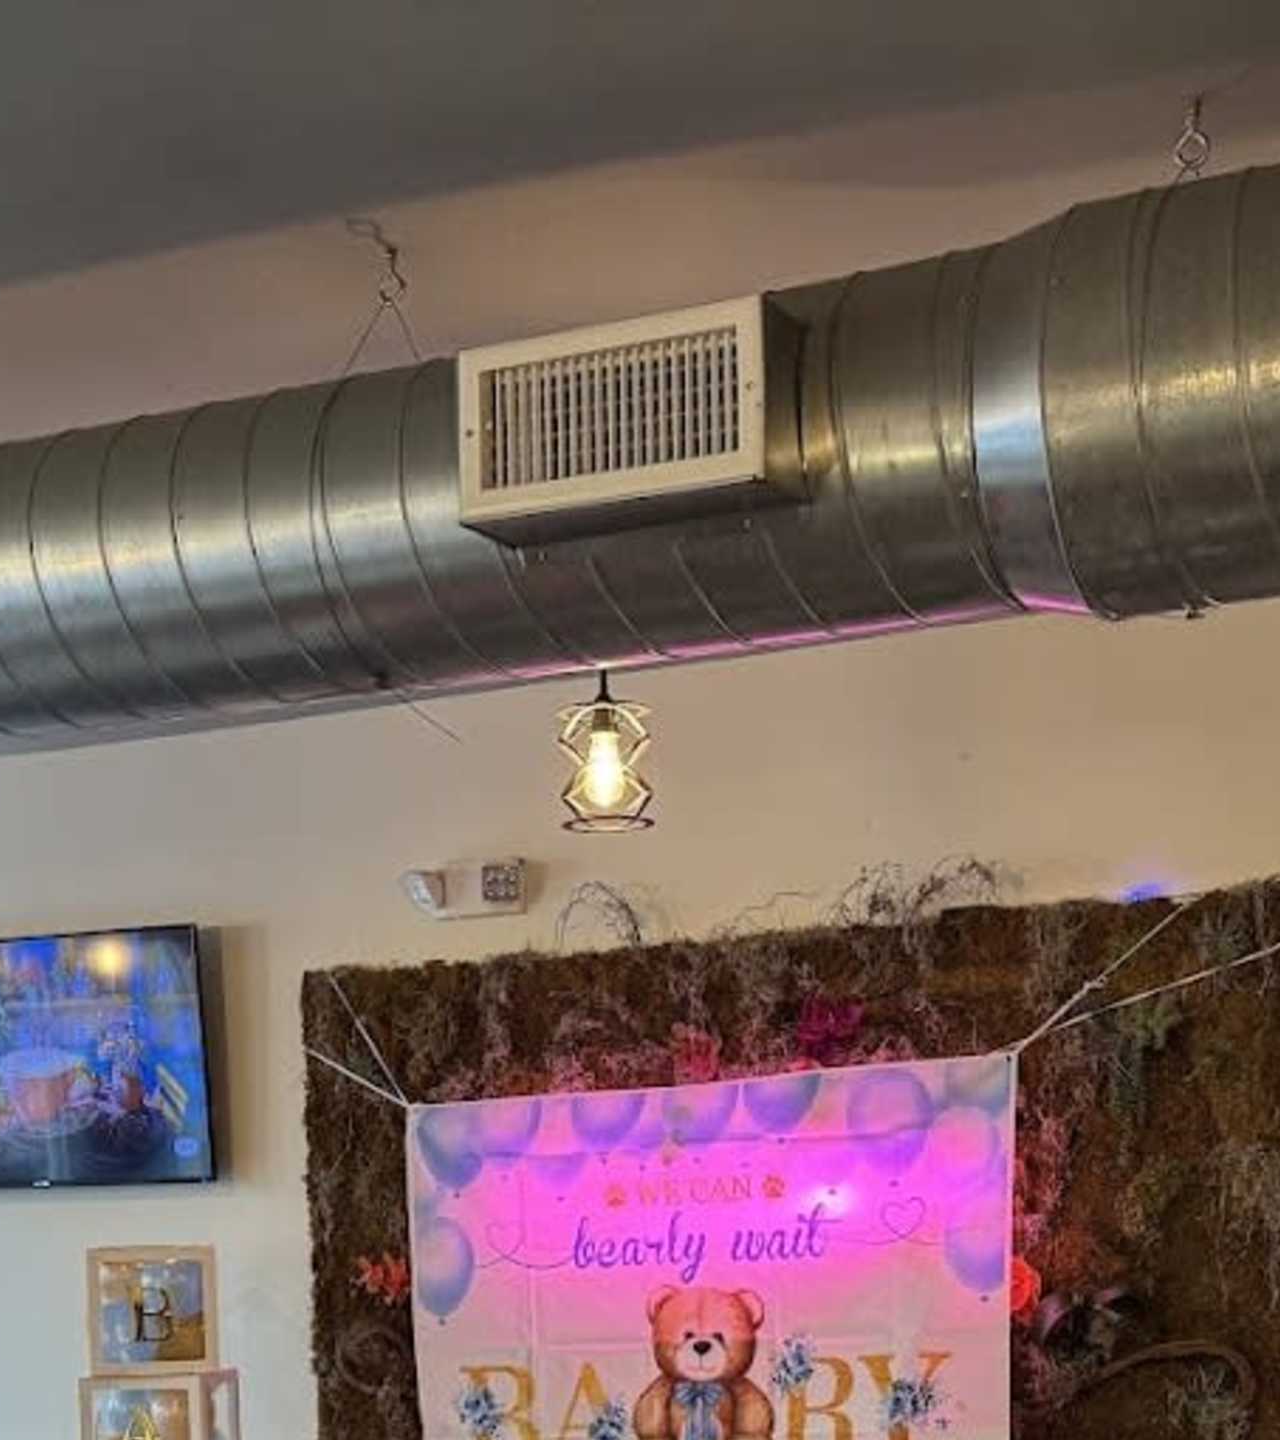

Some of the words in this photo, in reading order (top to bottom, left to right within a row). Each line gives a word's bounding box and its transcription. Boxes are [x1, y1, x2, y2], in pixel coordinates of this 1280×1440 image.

[639, 1178, 683, 1206] WE
[689, 1174, 753, 1205] CAN
[572, 1209, 706, 1284] bearly
[730, 1200, 844, 1263] wait
